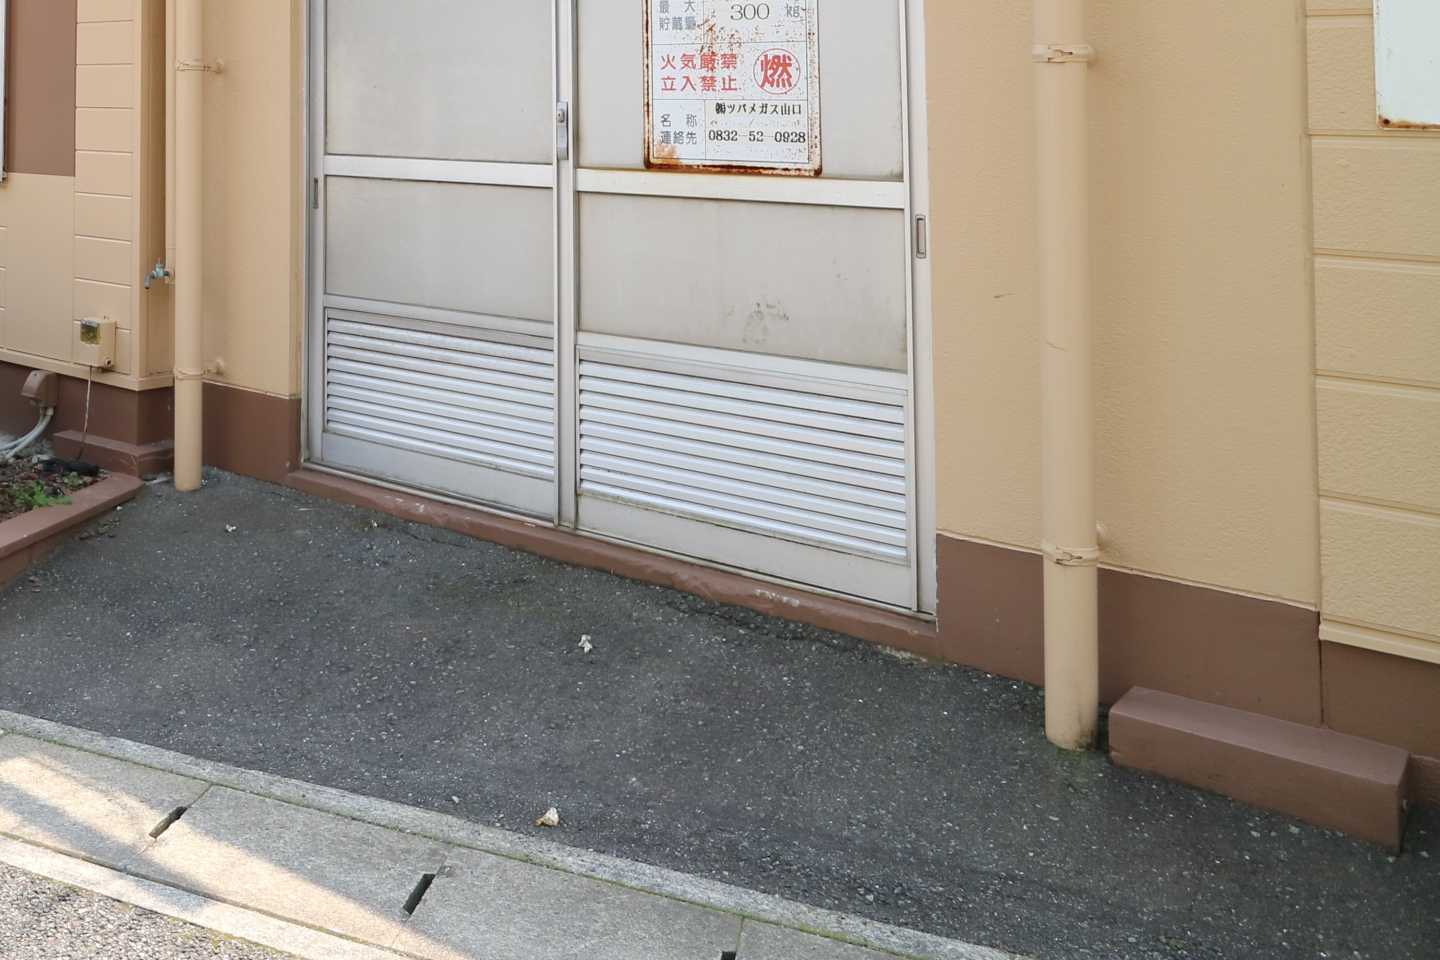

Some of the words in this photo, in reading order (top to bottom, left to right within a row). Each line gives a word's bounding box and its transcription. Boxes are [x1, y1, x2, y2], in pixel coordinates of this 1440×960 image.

[730, 3, 770, 21] 300
[786, 4, 800, 19] kg
[659, 16, 696, 31] 貯蔵量
[660, 53, 738, 71] 火気厳禁
[760, 54, 793, 89] 燃
[661, 75, 738, 92] 立入禁止
[660, 131, 697, 145] 連絡先
